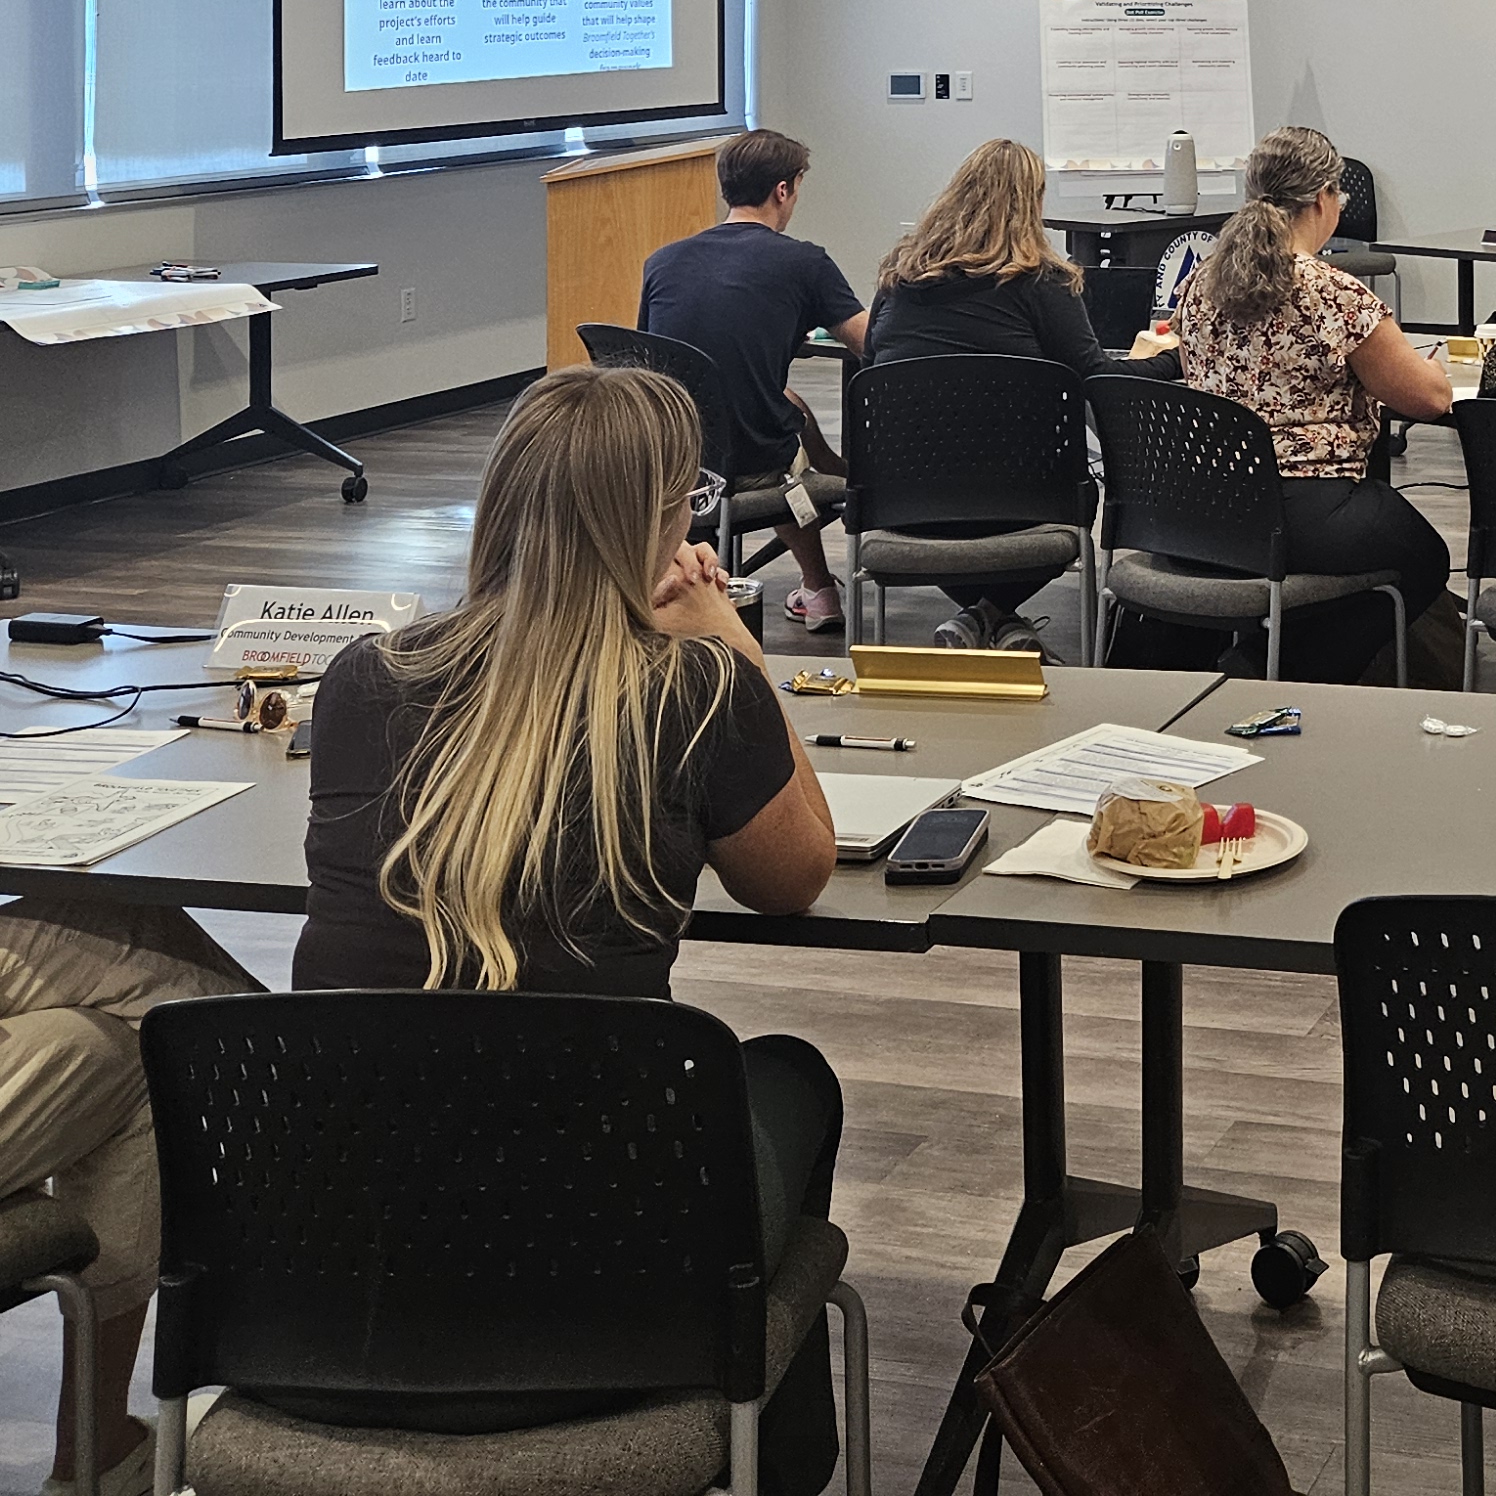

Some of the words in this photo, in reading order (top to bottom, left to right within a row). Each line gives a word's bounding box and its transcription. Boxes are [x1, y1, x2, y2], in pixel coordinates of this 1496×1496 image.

[380, 16, 421, 31] project's
[424, 15, 455, 26] efforts
[494, 14, 509, 25] will
[512, 14, 530, 26] help
[533, 13, 556, 26] guide
[583, 16, 599, 26] that
[616, 15, 632, 26] help
[634, 15, 655, 25] shape
[396, 34, 414, 45] and
[417, 33, 441, 44] learn
[485, 31, 522, 45] strategic
[525, 32, 565, 40] outcomes
[374, 52, 419, 66] feedback
[422, 51, 449, 62] heard
[452, 51, 461, 60] to
[589, 47, 650, 58] decision-making
[406, 71, 427, 82] date
[1156, 263, 1166, 289] AND
[1164, 232, 1198, 260] COUNTY
[1200, 232, 1213, 243] OF
[260, 600, 315, 621] Katie
[320, 604, 375, 626] Allen
[220, 627, 281, 643] Community
[283, 630, 354, 644] Development
